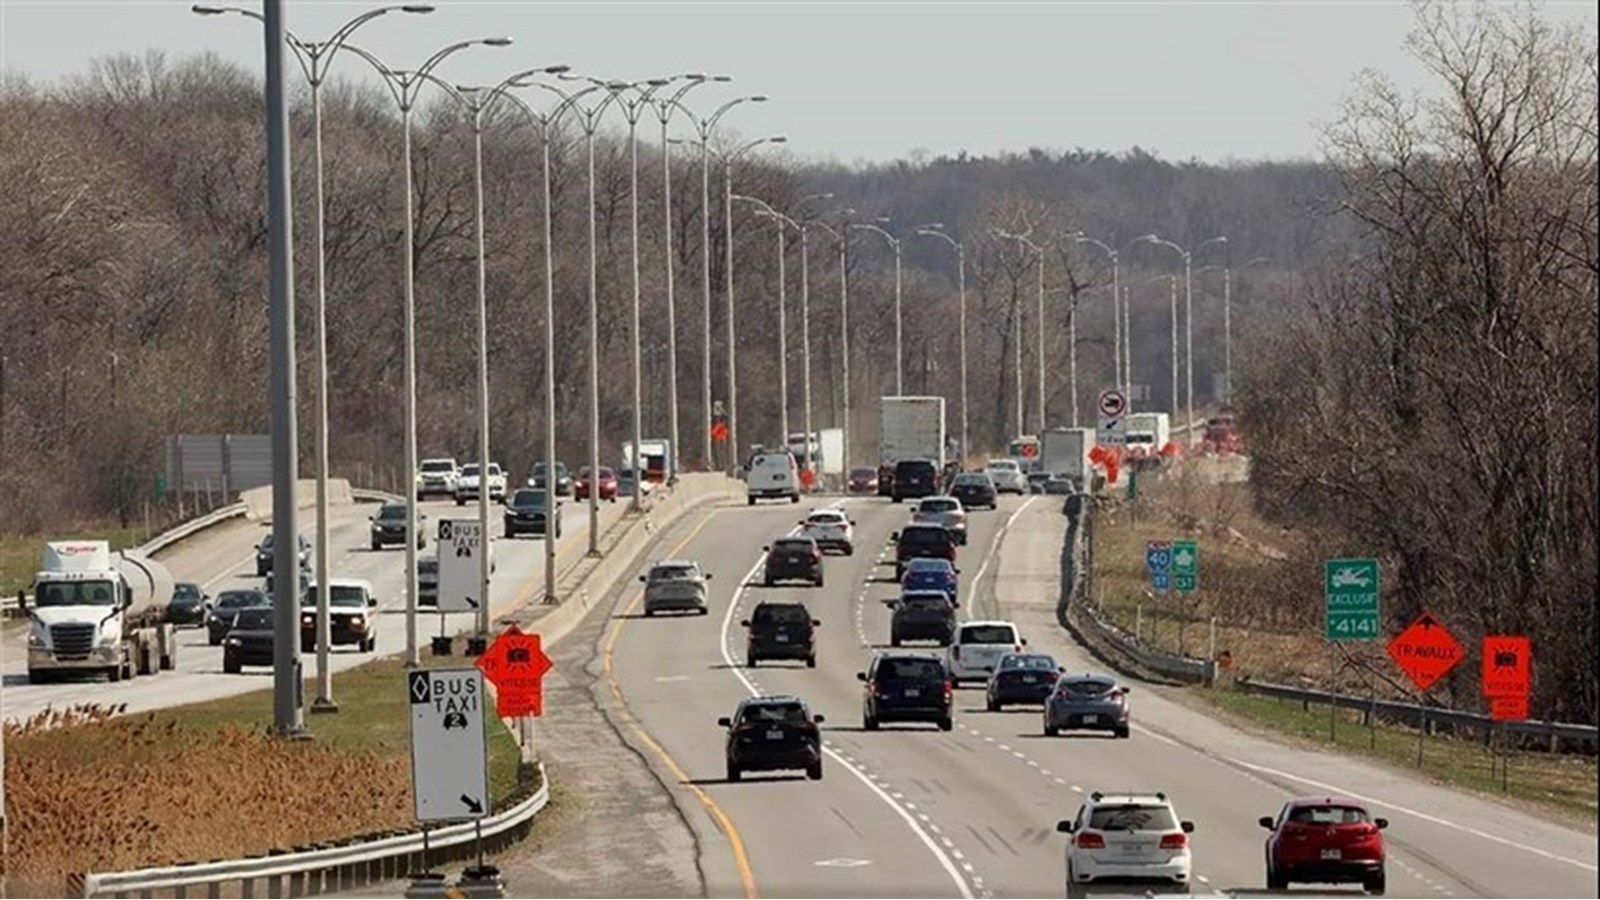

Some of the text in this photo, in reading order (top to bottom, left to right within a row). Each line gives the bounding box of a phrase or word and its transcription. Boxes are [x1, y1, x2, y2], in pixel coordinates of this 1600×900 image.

[454, 525, 480, 536] BUS
[452, 537, 479, 548] TAXI
[1149, 552, 1168, 565] 40
[1328, 592, 1377, 605] EXCLUSIF
[1396, 643, 1456, 660] TRAVAUX
[433, 677, 476, 696] BUS
[433, 695, 477, 713] TAXI
[450, 713, 461, 727] 2
